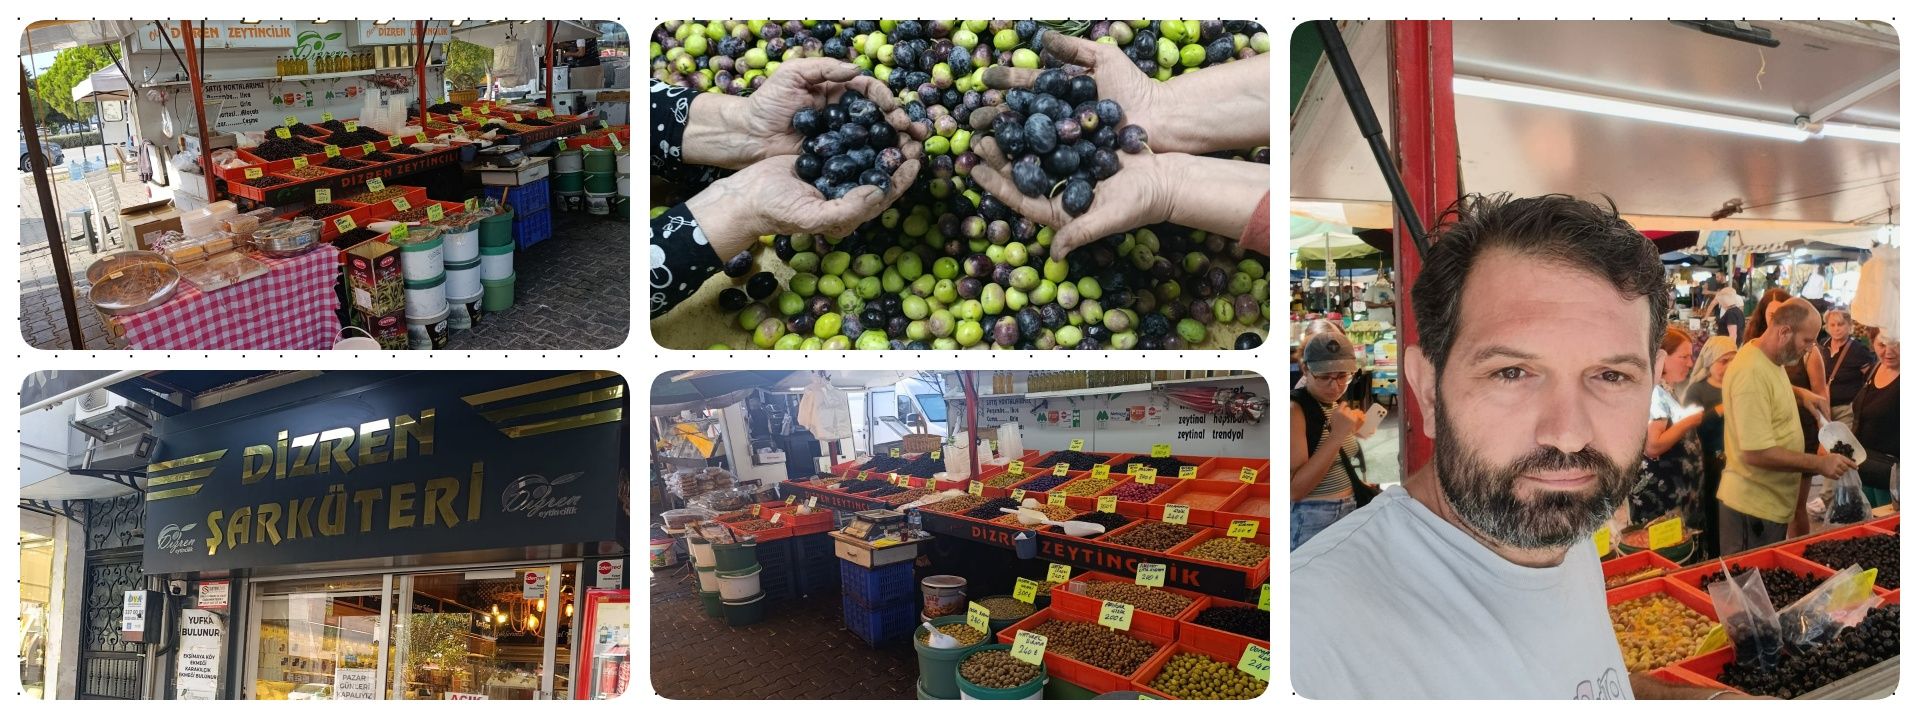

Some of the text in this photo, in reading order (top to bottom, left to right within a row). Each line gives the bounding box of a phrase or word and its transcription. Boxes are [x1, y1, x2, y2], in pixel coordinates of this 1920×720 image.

[228, 25, 292, 39] ZEYTİNCİLİK
[1178, 413, 1206, 426] zeytinal
[1178, 429, 1244, 441] zeytinal trendyol
[242, 408, 435, 486] DİZREN
[206, 461, 485, 556] ŞARKÜTERİ
[188, 616, 214, 625] YUFKA
[182, 628, 220, 637] BULUNUR
[342, 674, 367, 682] PAZAR
[339, 682, 371, 690] GÜNLERİ
[336, 691, 373, 700] KAPALIYIZ
